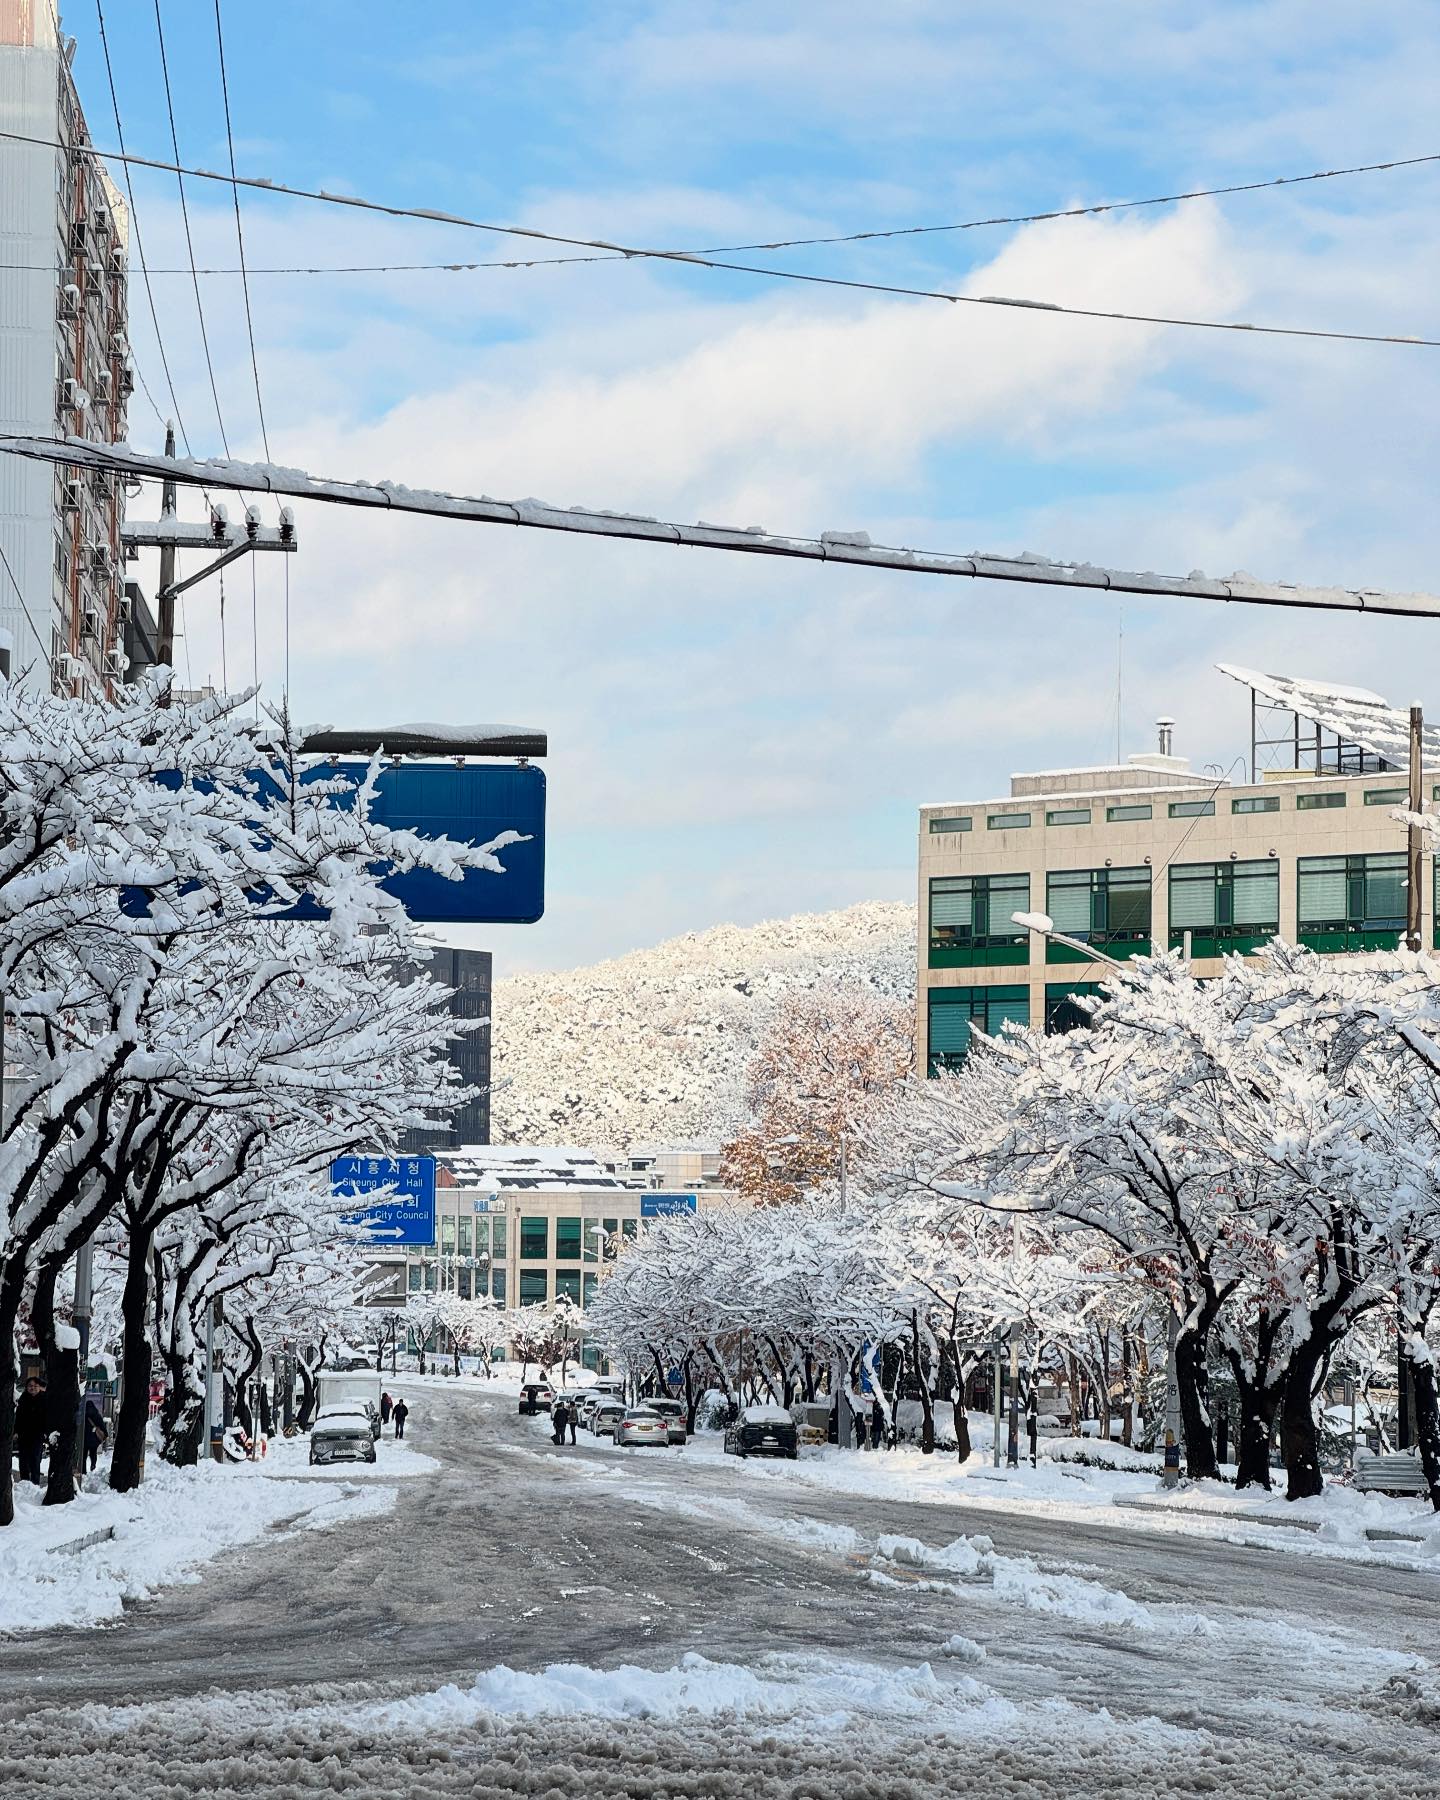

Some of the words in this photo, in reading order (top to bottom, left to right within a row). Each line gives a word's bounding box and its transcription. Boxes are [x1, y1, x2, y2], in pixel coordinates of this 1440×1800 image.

[406, 1178, 423, 1188] Hall
[375, 1210, 393, 1221] City
[396, 1210, 429, 1220] Council
